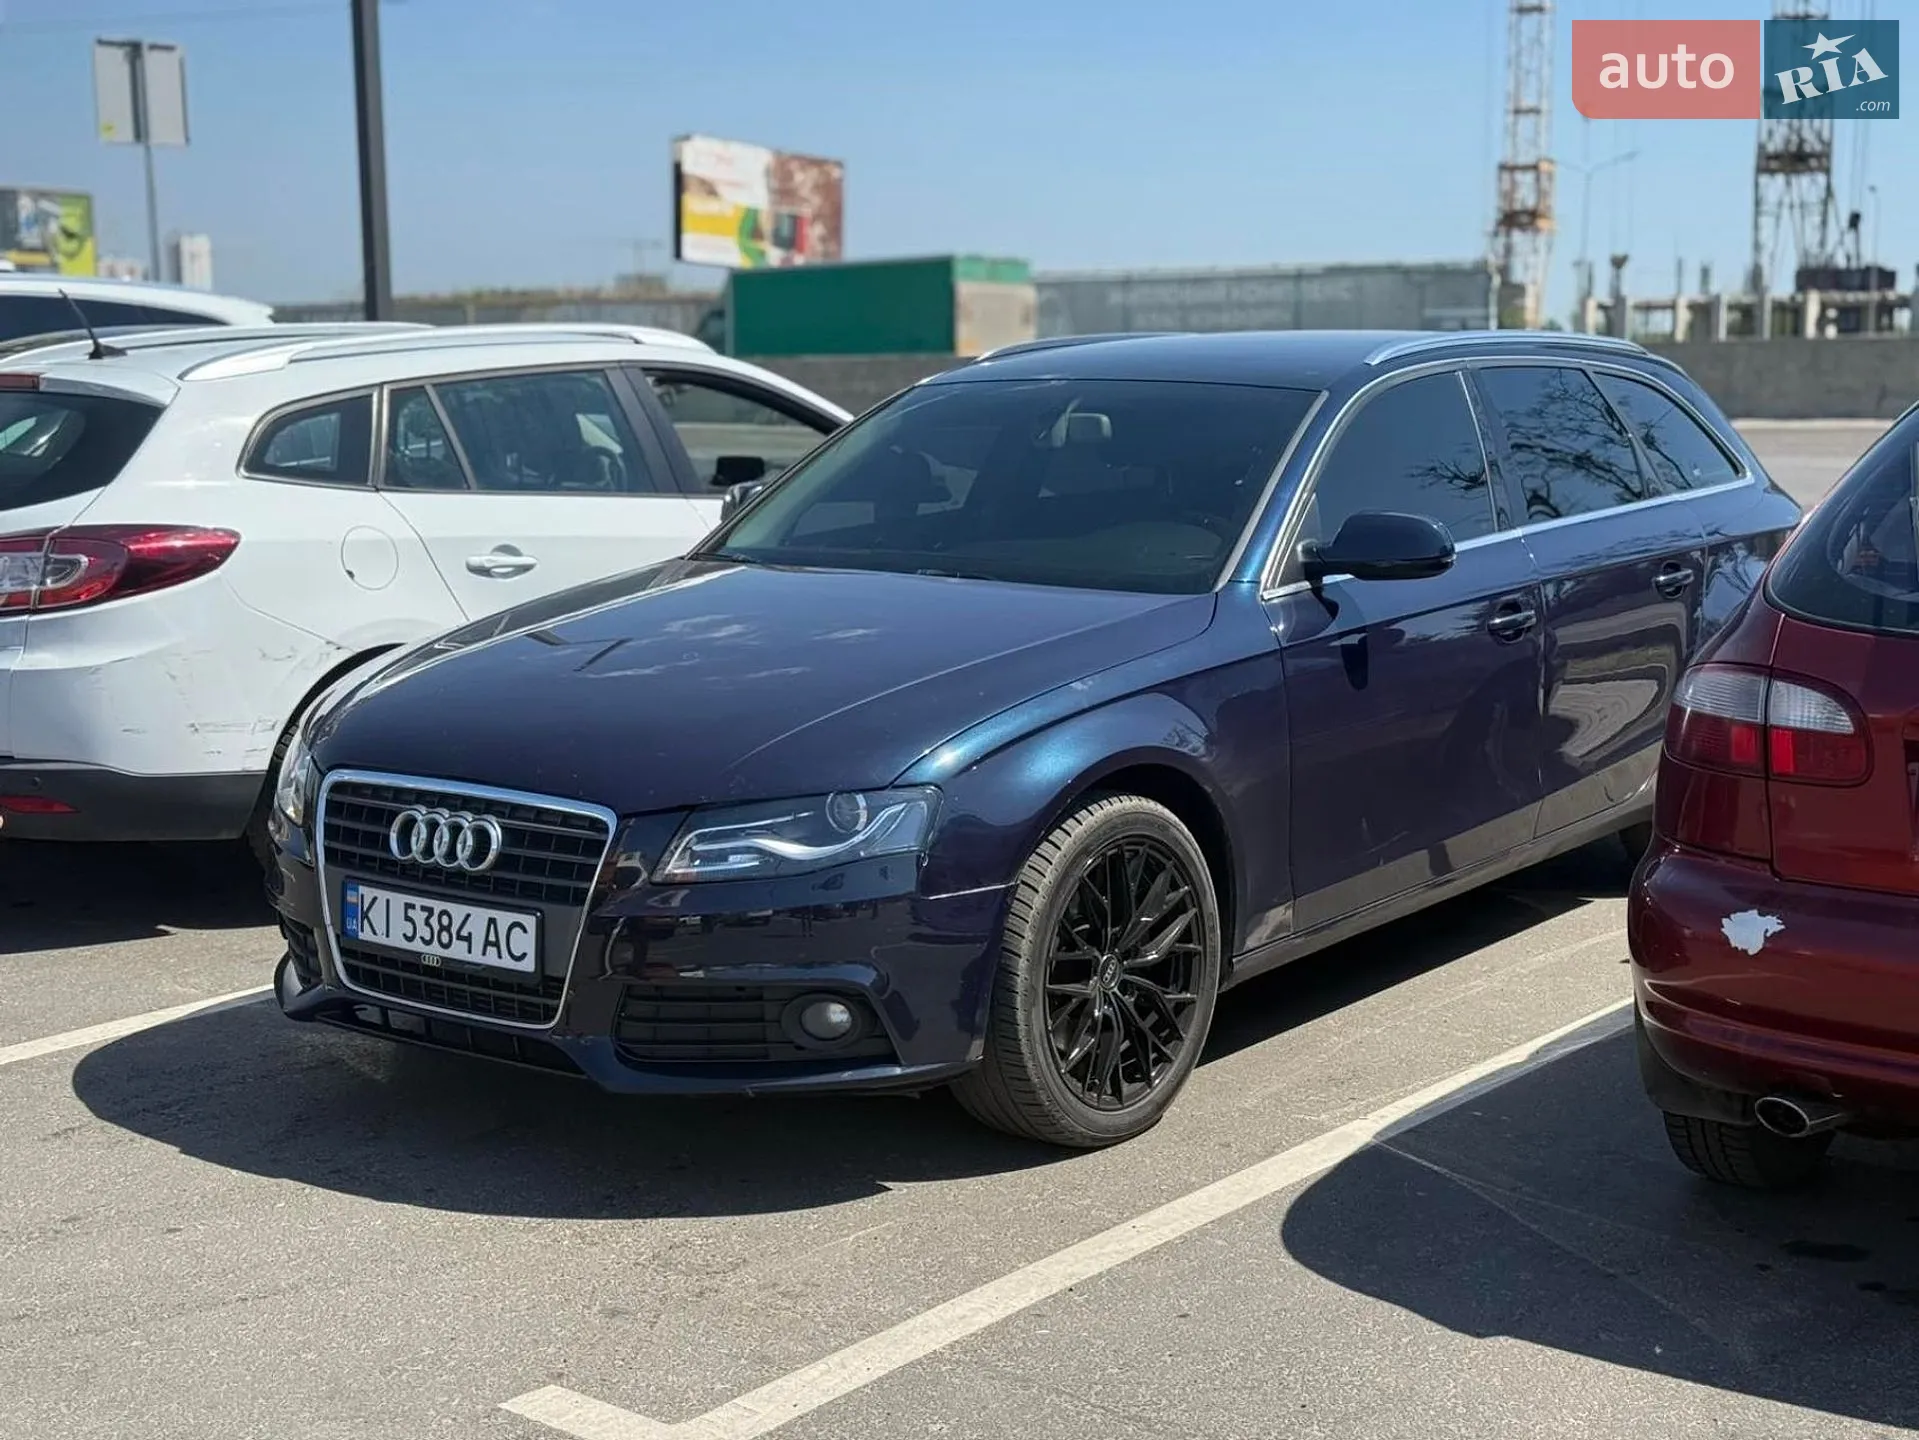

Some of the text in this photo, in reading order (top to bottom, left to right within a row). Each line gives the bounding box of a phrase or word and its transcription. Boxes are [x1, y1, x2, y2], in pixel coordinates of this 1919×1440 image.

[360, 893, 528, 962] KI 5384 AC
